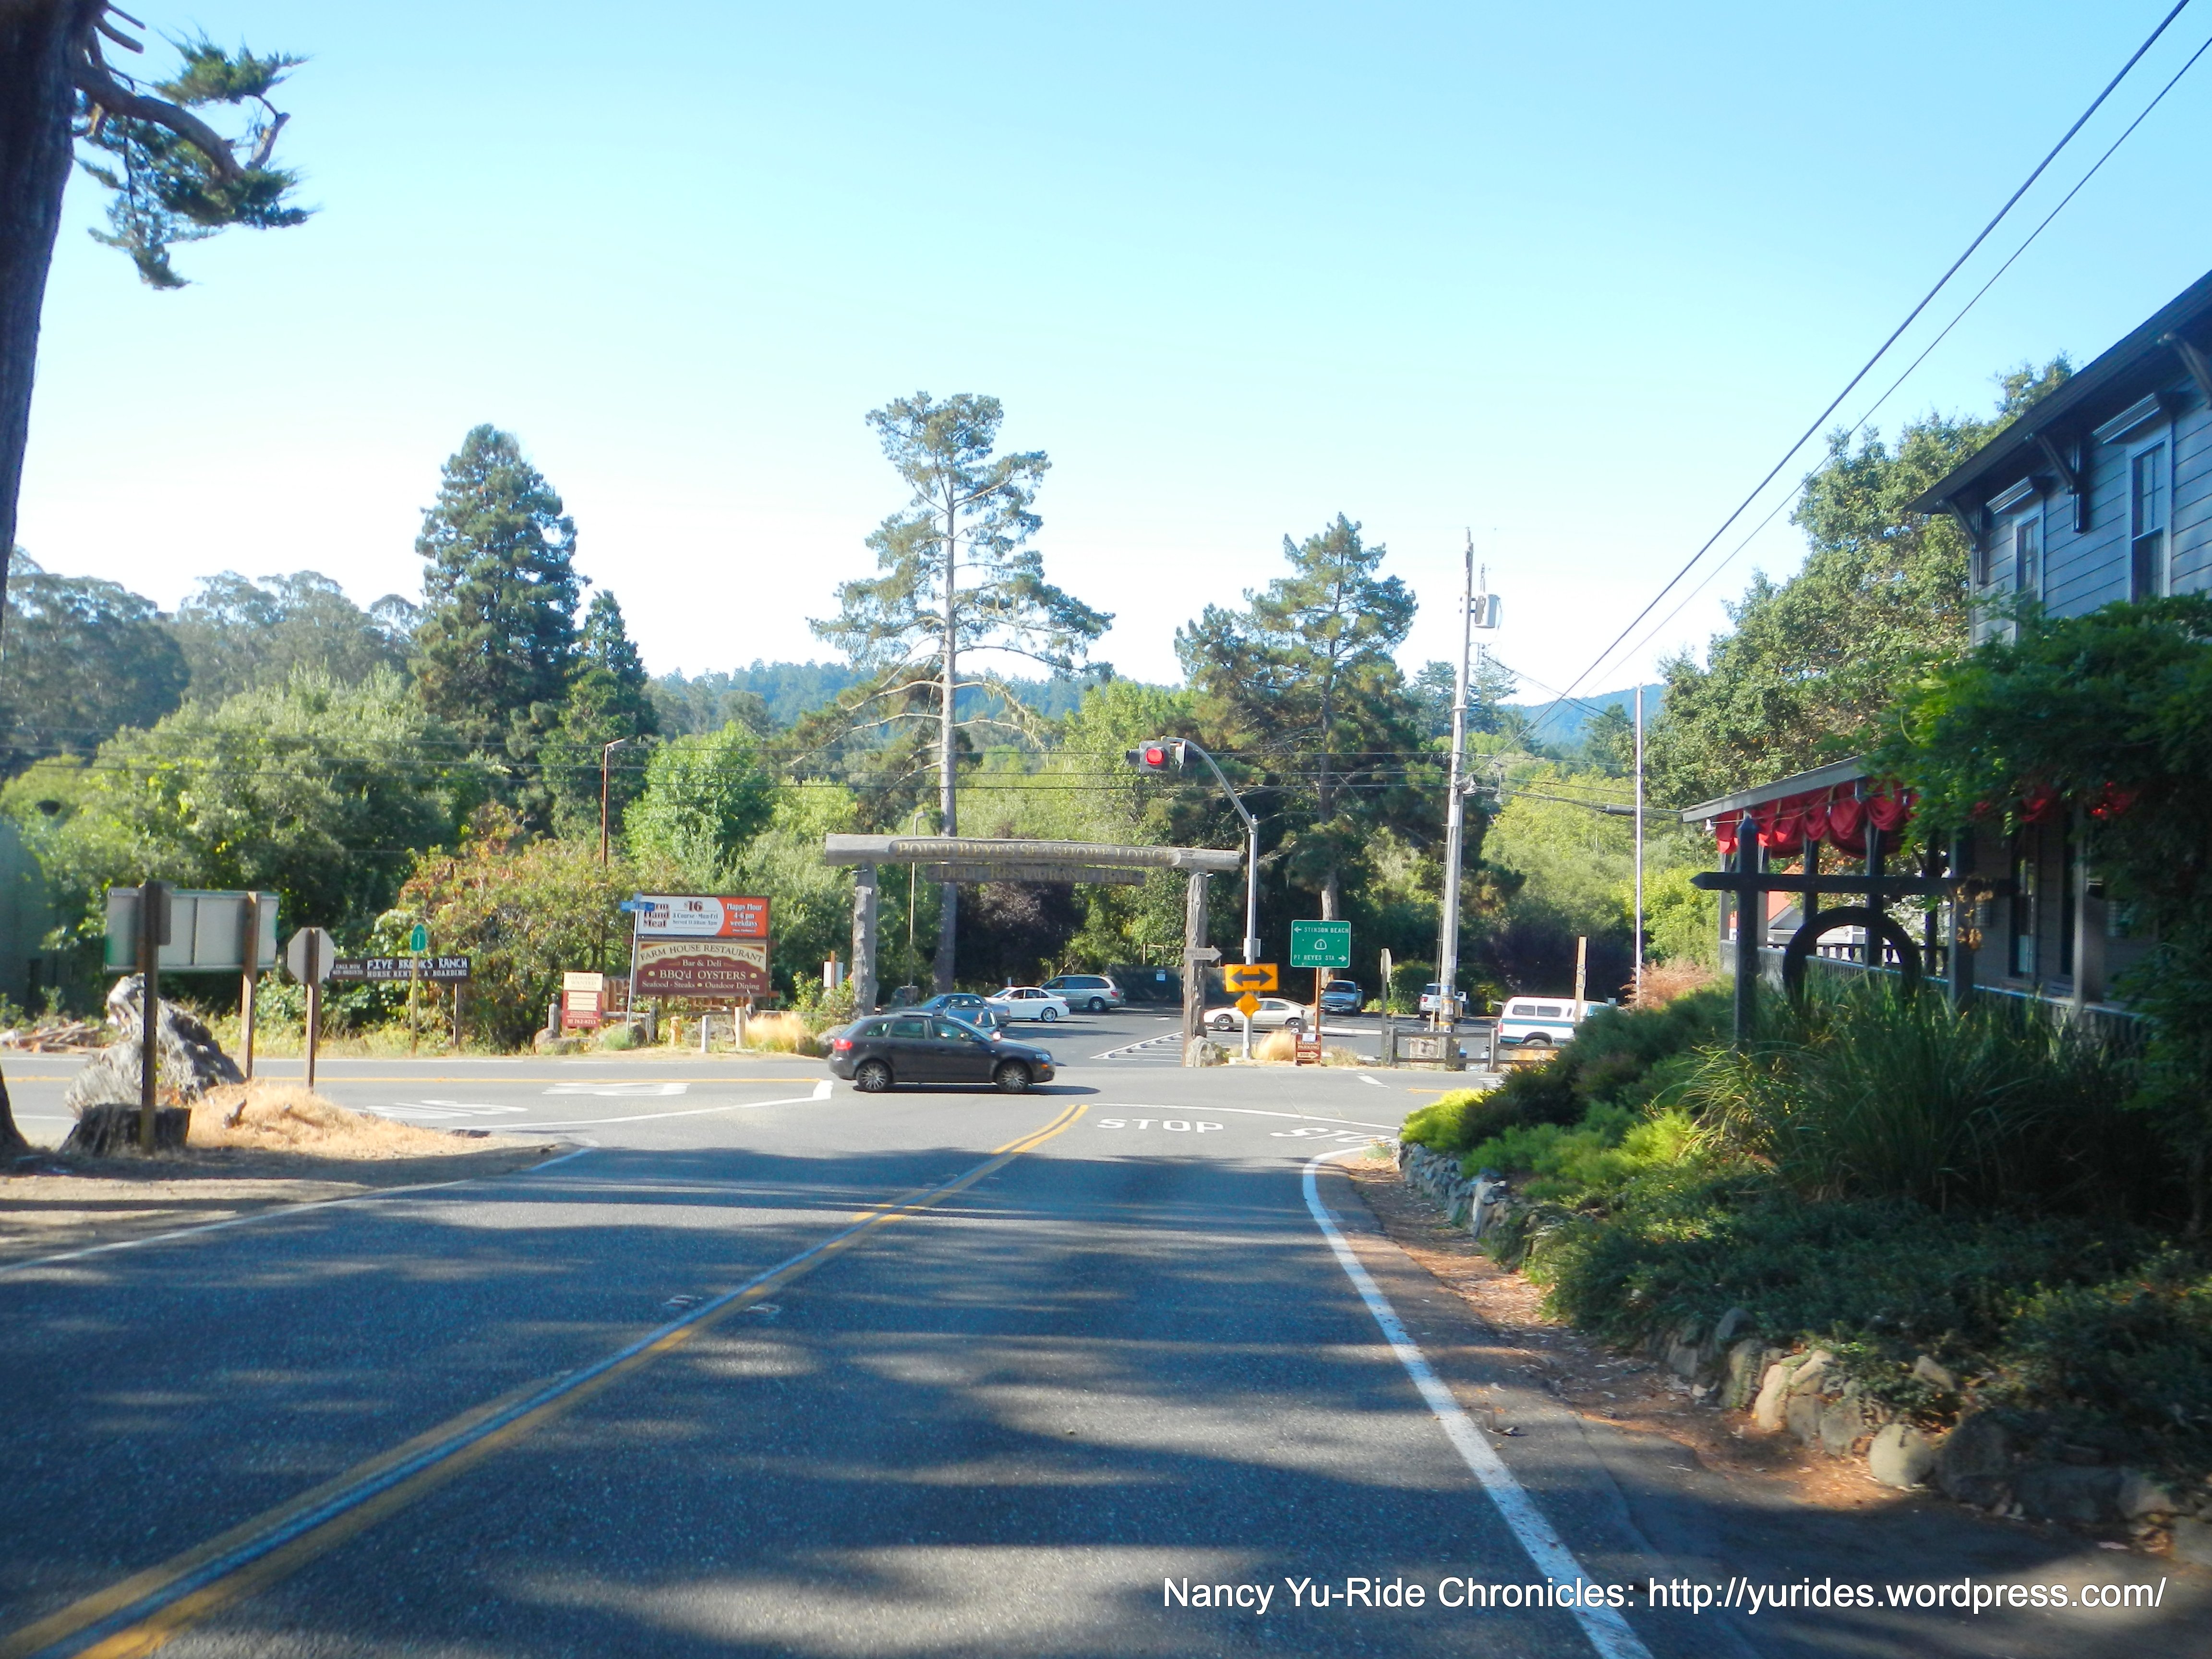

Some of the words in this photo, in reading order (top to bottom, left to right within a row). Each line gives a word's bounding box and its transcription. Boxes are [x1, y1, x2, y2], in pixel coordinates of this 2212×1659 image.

[897, 842, 954, 857] POINT
[958, 842, 1015, 858] REYES
[1019, 843, 1110, 859] SEASHORE
[726, 902, 745, 911] Happy
[640, 948, 666, 961] FARM
[669, 944, 701, 954] HOUSE
[704, 944, 764, 962] RESTAURANT
[367, 959, 394, 970] FIVE
[438, 958, 468, 969] RANCH
[659, 970, 692, 980] BBQ'd
[697, 970, 746, 980] OYSTERS
[736, 982, 760, 990] Dining
[1096, 1118, 1225, 1133] STOP
